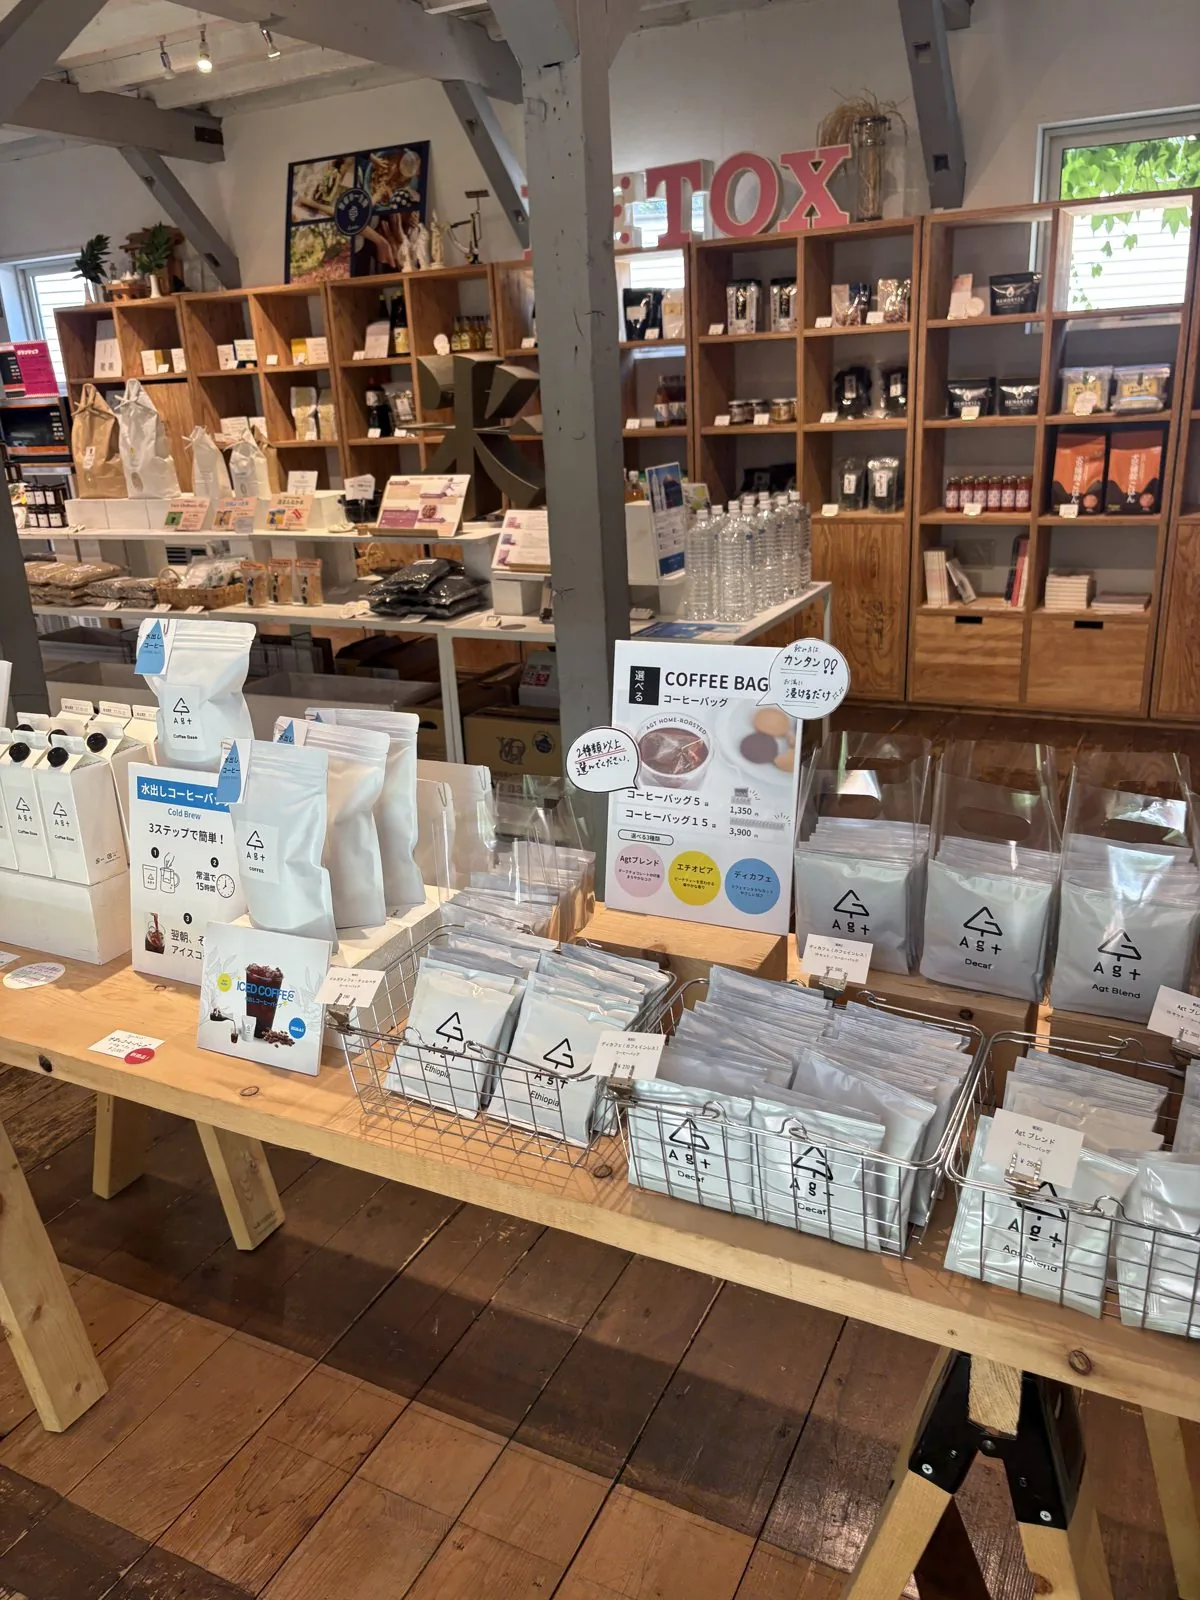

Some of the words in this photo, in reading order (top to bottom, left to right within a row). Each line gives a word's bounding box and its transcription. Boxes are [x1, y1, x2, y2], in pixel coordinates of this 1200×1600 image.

[634, 670, 645, 702] 選べる
[665, 671, 729, 690] COFFEE
[734, 676, 769, 692] BAG
[663, 695, 728, 708] コーヒーバッグ
[646, 720, 658, 731] AGT
[141, 783, 229, 807] 水出しコーヒーバ
[168, 808, 182, 817] Cold
[184, 810, 202, 820] Brew
[730, 806, 752, 816] 1,350
[149, 822, 224, 844] 3ステップで簡単！
[729, 828, 751, 838] 3,900
[620, 855, 660, 867] Agtブレンド
[676, 863, 714, 875] エチオピア
[196, 870, 216, 882] 常温で
[734, 870, 772, 883] ディカフェ
[196, 882, 216, 893] 15時間
[171, 945, 204, 960] アイスコ
[965, 958, 993, 970] Decaf
[237, 980, 257, 994] ICED
[258, 985, 295, 1002] COFFEE
[1092, 983, 1109, 994] Agt
[1112, 987, 1141, 999] Blend
[424, 1063, 450, 1079] Ethiopia
[530, 1089, 560, 1107] Ethiopia
[1027, 1132, 1056, 1145] ブレンド
[677, 1170, 705, 1183] Decaf
[797, 1203, 827, 1216] Decaf
[1024, 1253, 1058, 1273] Blend
